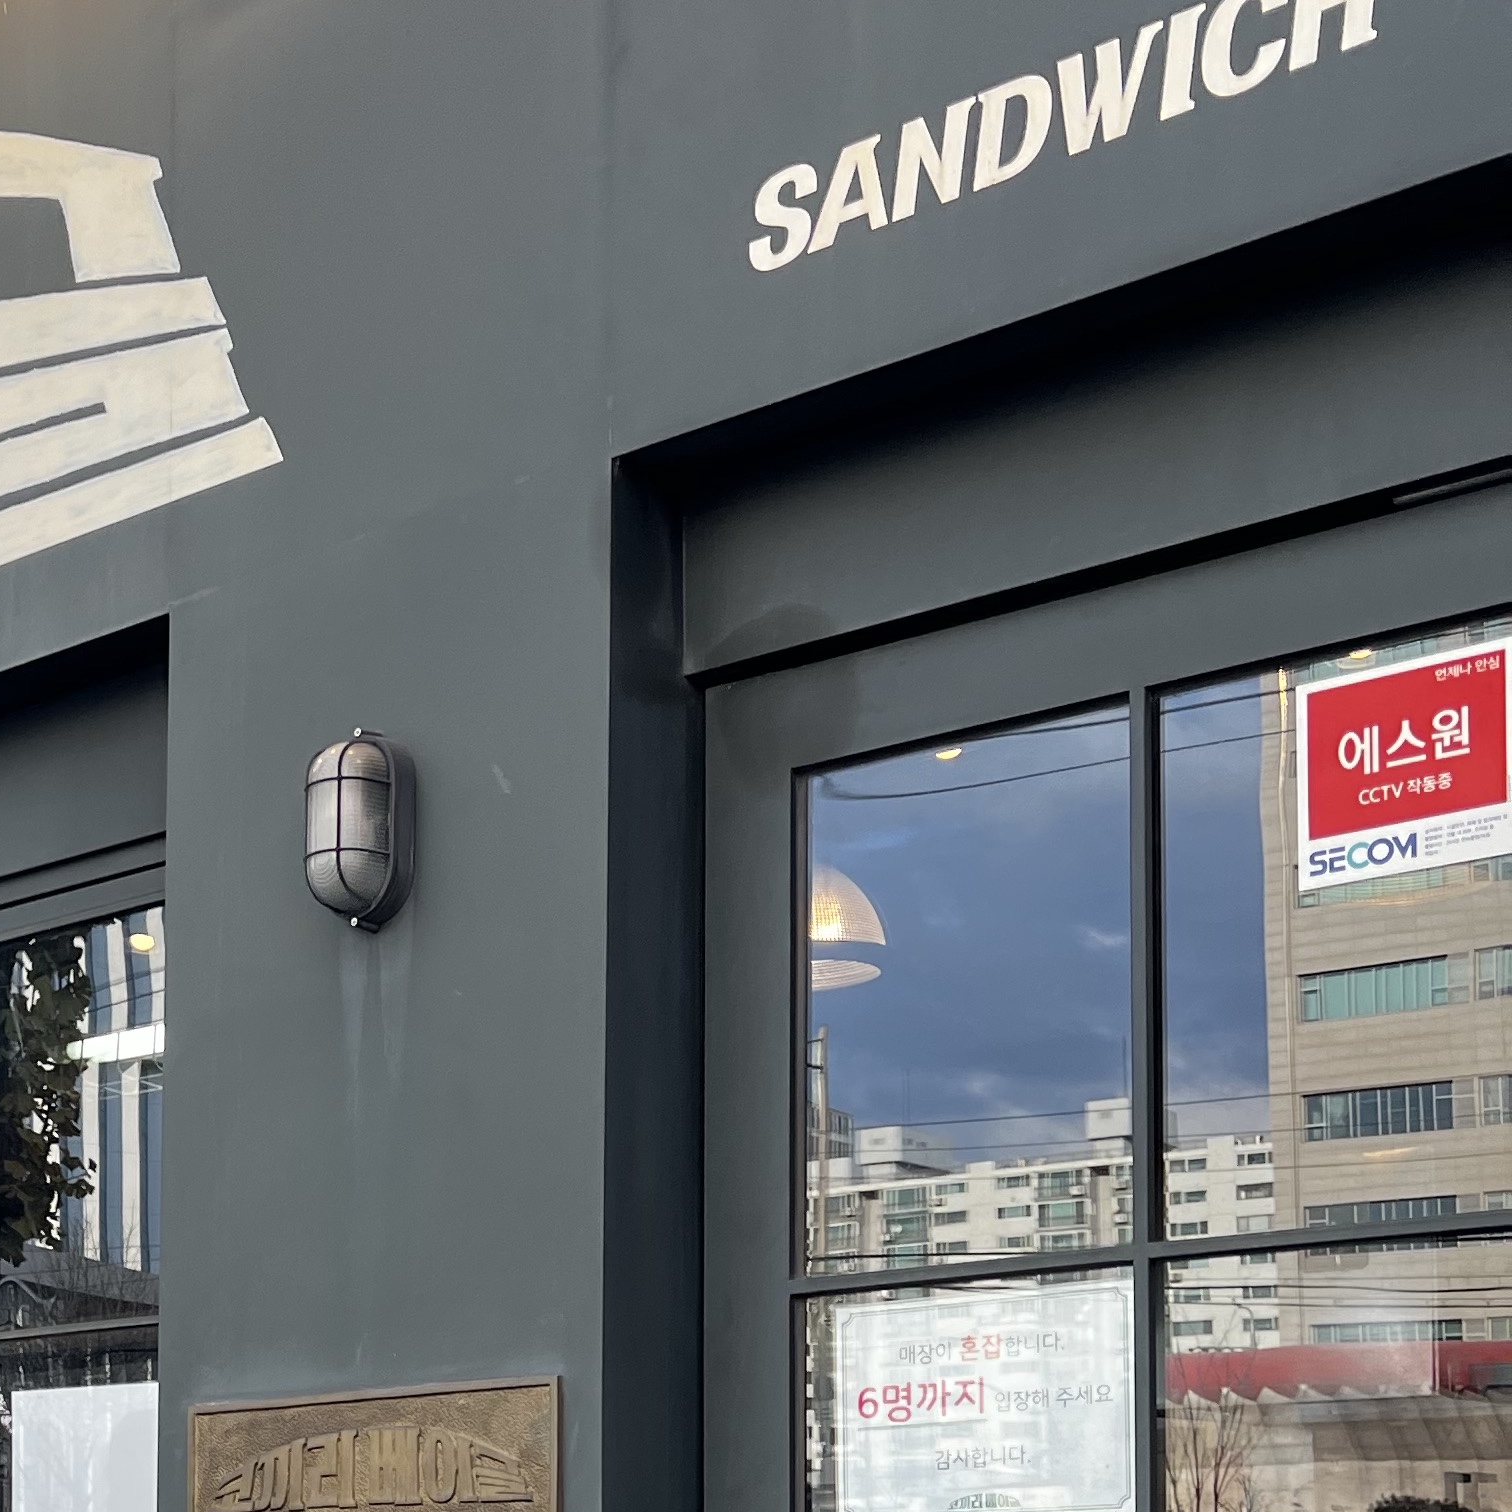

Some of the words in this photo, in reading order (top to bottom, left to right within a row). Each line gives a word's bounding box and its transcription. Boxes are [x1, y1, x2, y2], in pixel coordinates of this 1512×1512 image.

[749, 0, 1377, 271] SANDWICH
[1435, 662, 1472, 681] 언제나
[1475, 655, 1500, 672] 안심
[1338, 705, 1471, 775] 에스원
[1358, 781, 1404, 805] CCTV
[1407, 772, 1453, 795] 작동중
[1309, 832, 1418, 877] SECOM
[899, 1342, 952, 1365] 매장이
[959, 1331, 1065, 1362] 혼잡합니다.
[857, 1376, 985, 1422] 6명까지
[994, 1388, 1049, 1412] 입장해
[1055, 1384, 1114, 1408] 주세요
[367, 1425, 534, 1507] 베이글
[935, 1445, 1031, 1470] 감사합니다.
